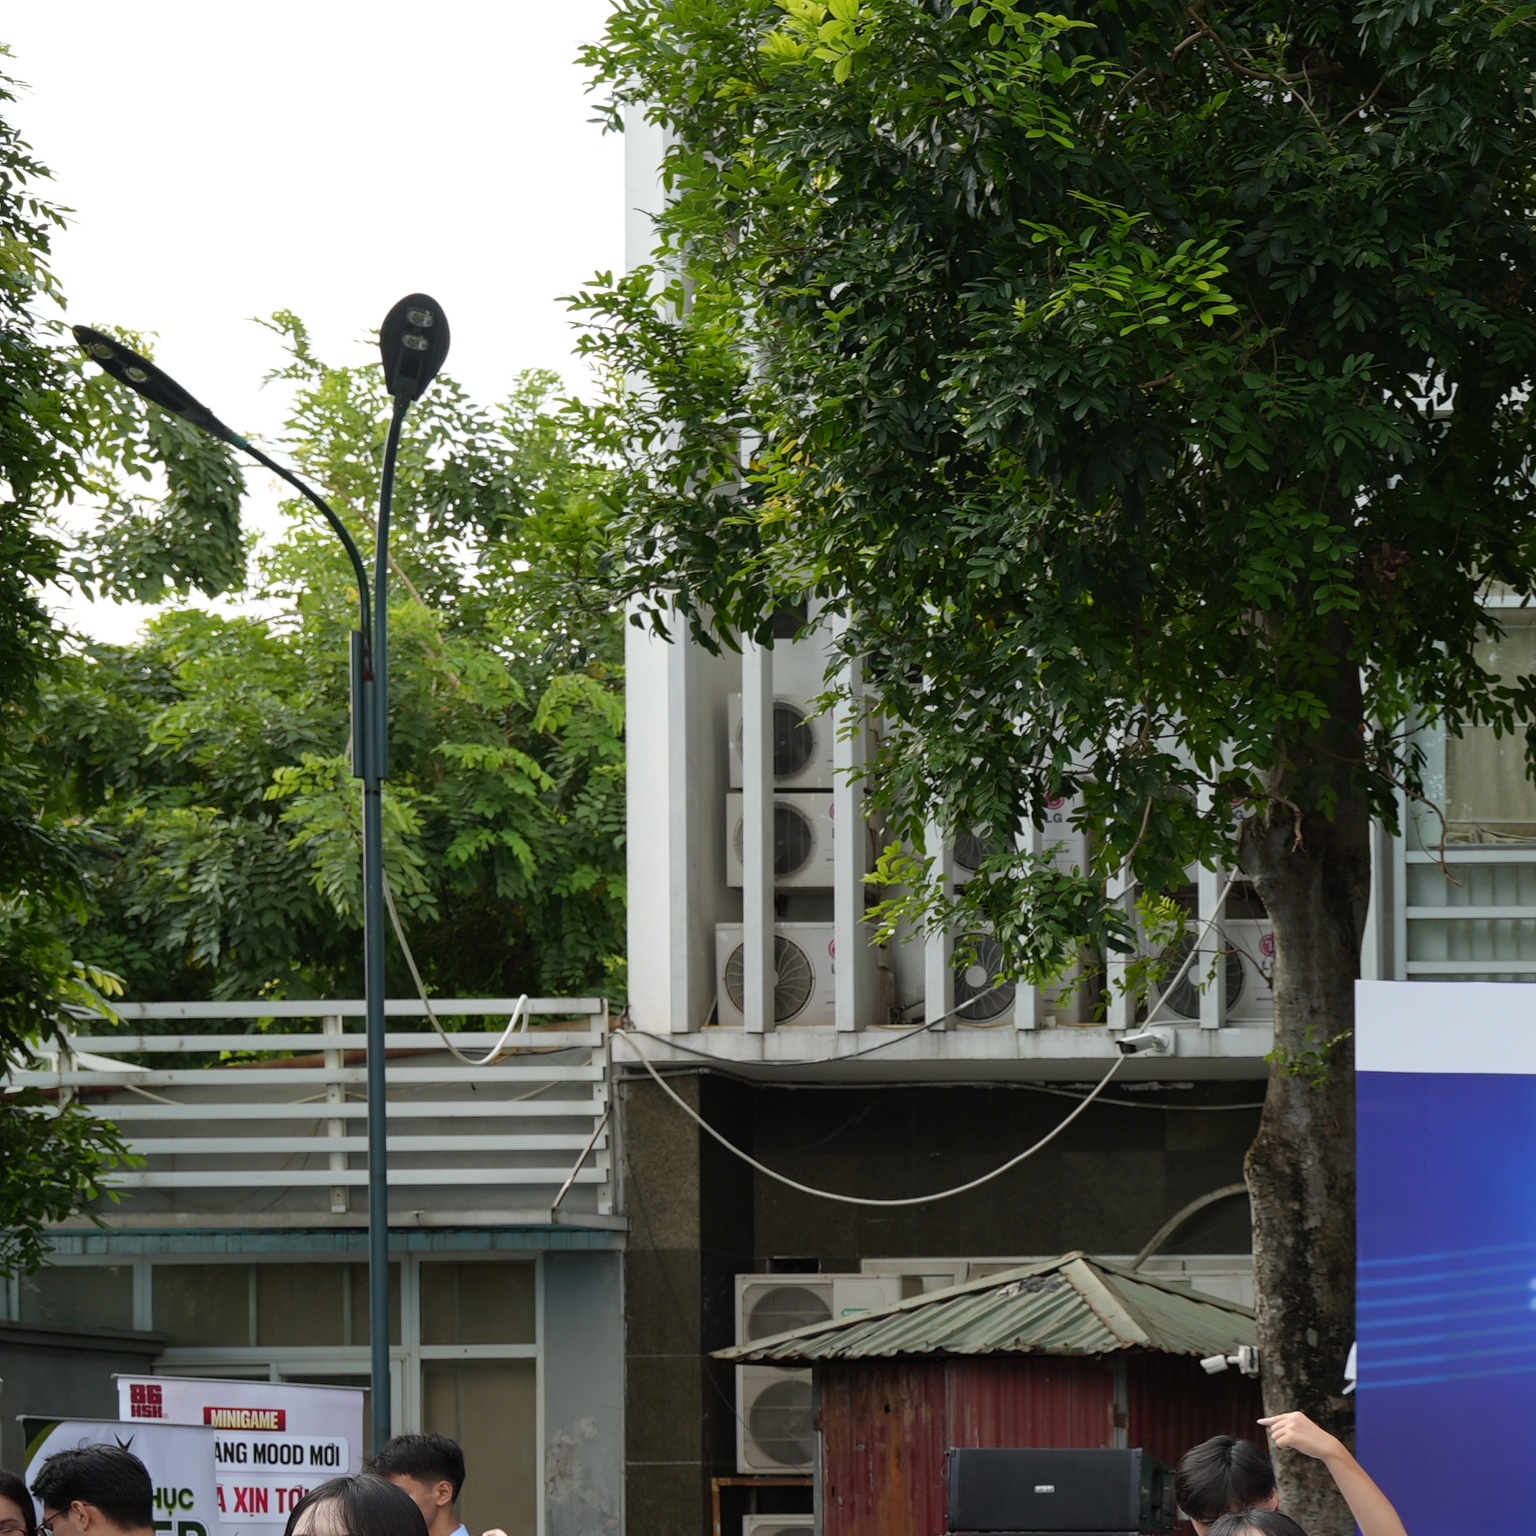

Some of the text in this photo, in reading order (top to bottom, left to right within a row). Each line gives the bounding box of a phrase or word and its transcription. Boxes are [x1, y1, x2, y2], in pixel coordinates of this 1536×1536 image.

[1045, 813, 1063, 823] LG
[210, 1408, 279, 1430] MINIGAME
[253, 1443, 304, 1465] MOOD
[310, 1443, 340, 1467] MỚI
[152, 1487, 195, 1516] HỤC
[233, 1487, 269, 1517] XỊN
